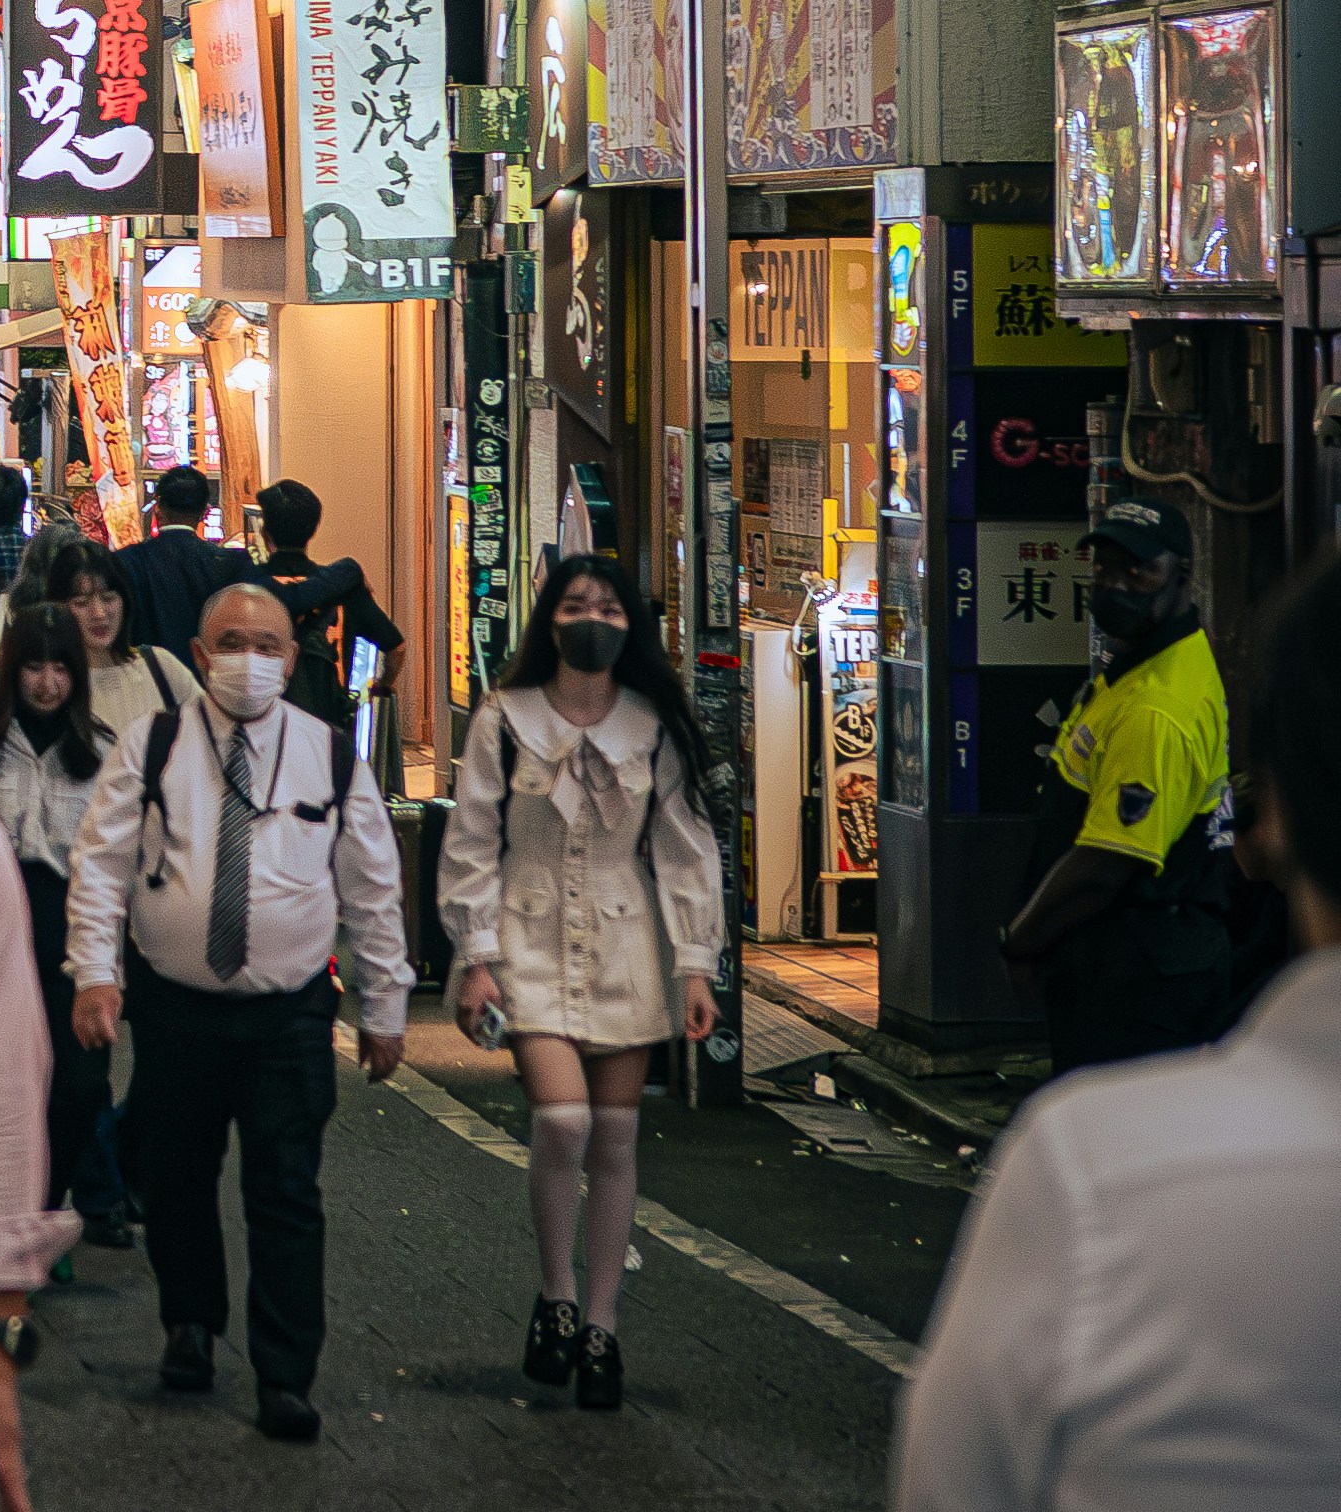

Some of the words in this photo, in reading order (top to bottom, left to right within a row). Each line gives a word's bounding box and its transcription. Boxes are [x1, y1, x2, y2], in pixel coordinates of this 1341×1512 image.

[144, 247, 166, 262] 5F
[380, 256, 452, 288] B1F
[740, 248, 828, 349] TEPPAN
[952, 270, 969, 320] 5F
[952, 419, 969, 468] 4F
[956, 568, 972, 619] 3F
